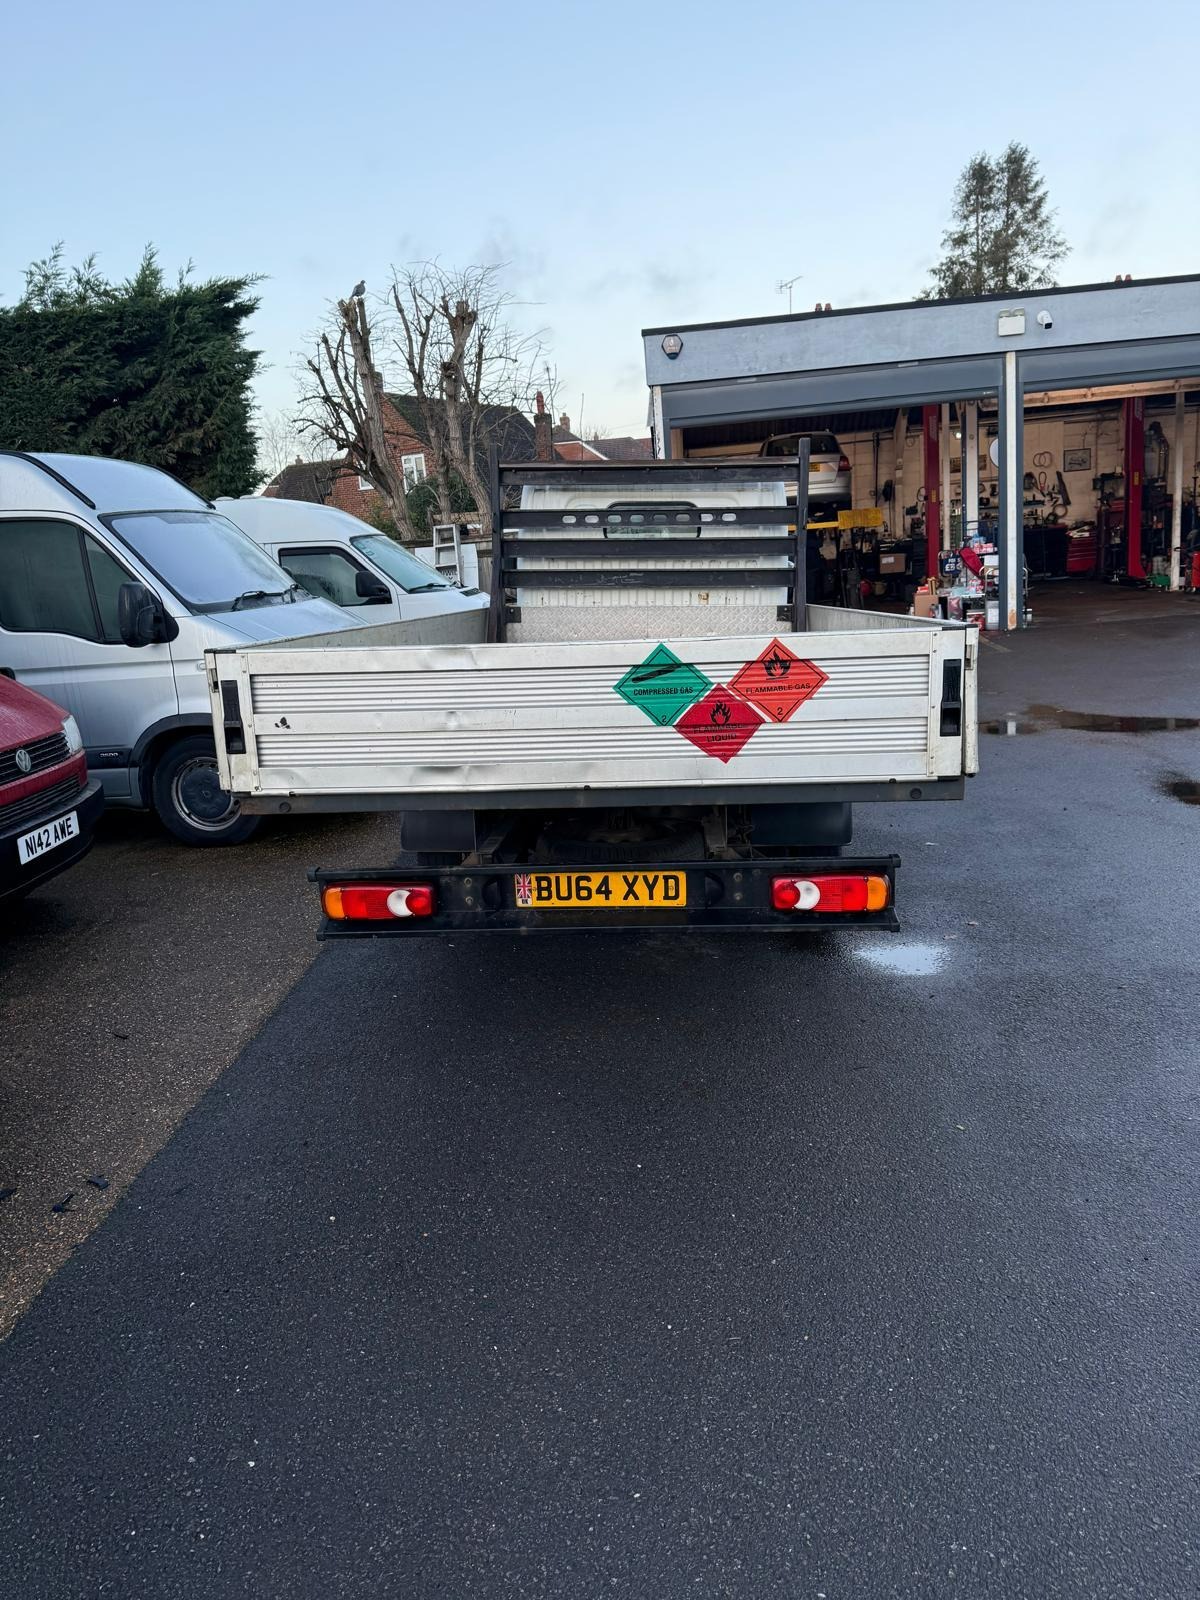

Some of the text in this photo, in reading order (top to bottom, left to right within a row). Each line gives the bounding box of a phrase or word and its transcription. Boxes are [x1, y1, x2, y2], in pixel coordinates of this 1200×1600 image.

[633, 688, 678, 696] COMPRESSED
[745, 682, 811, 694] FLAMMABLE GAS
[777, 707, 784, 716] 2
[661, 714, 668, 723] 2
[706, 734, 737, 742] LIQUID
[25, 817, 74, 858] N142 AWE
[535, 875, 680, 901] BU64 XYD
